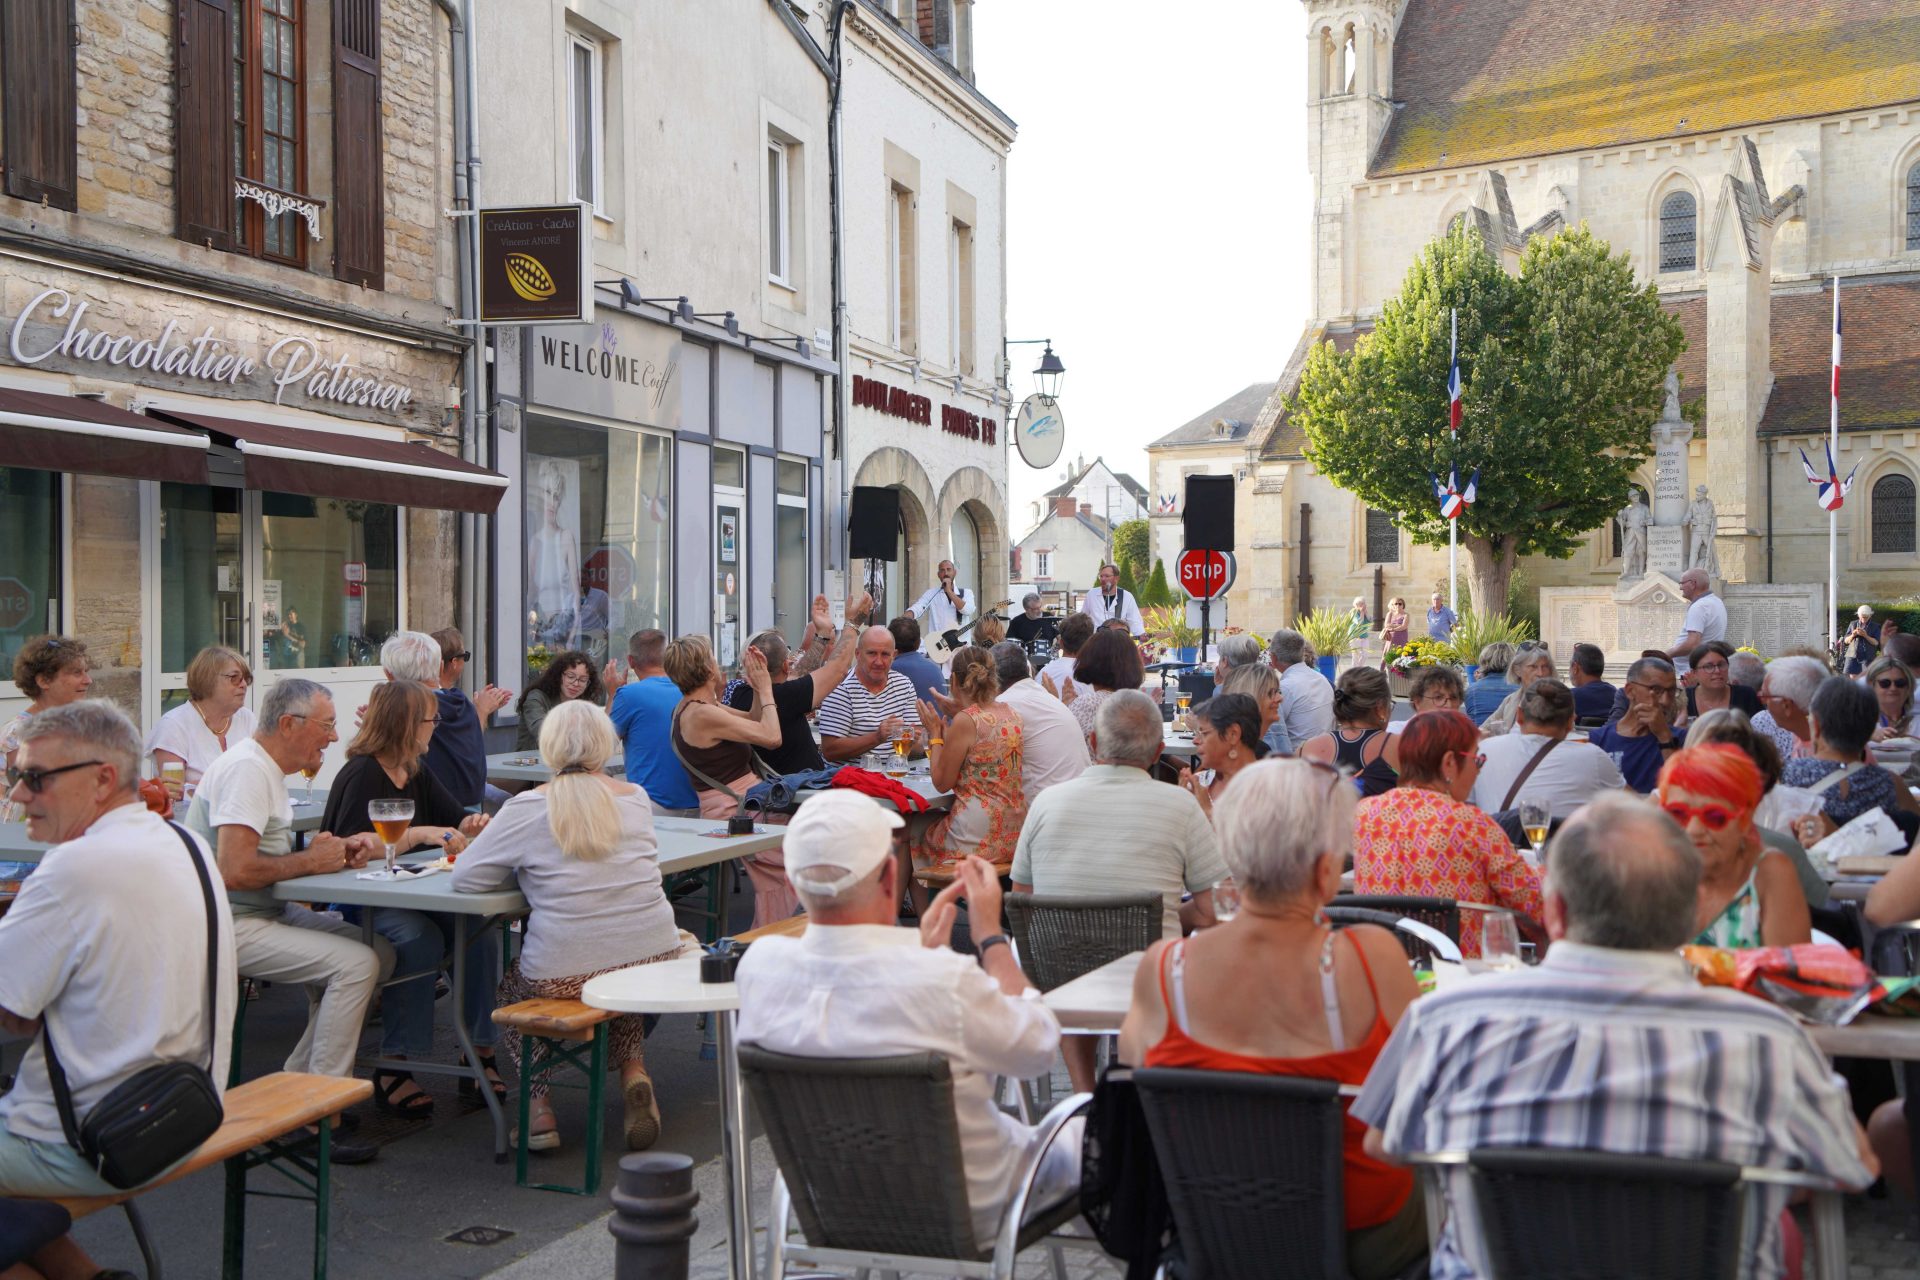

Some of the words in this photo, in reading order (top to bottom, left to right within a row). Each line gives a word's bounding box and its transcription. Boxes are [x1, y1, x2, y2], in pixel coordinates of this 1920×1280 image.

[500, 237, 530, 247] Vincent
[10, 289, 256, 385] Chocolatier
[264, 336, 413, 411] Pâtissier
[541, 335, 639, 385] WELCOME
[642, 359, 677, 409] Coiff
[852, 374, 932, 426] BOULANGER
[1184, 563, 1223, 580] STOP
